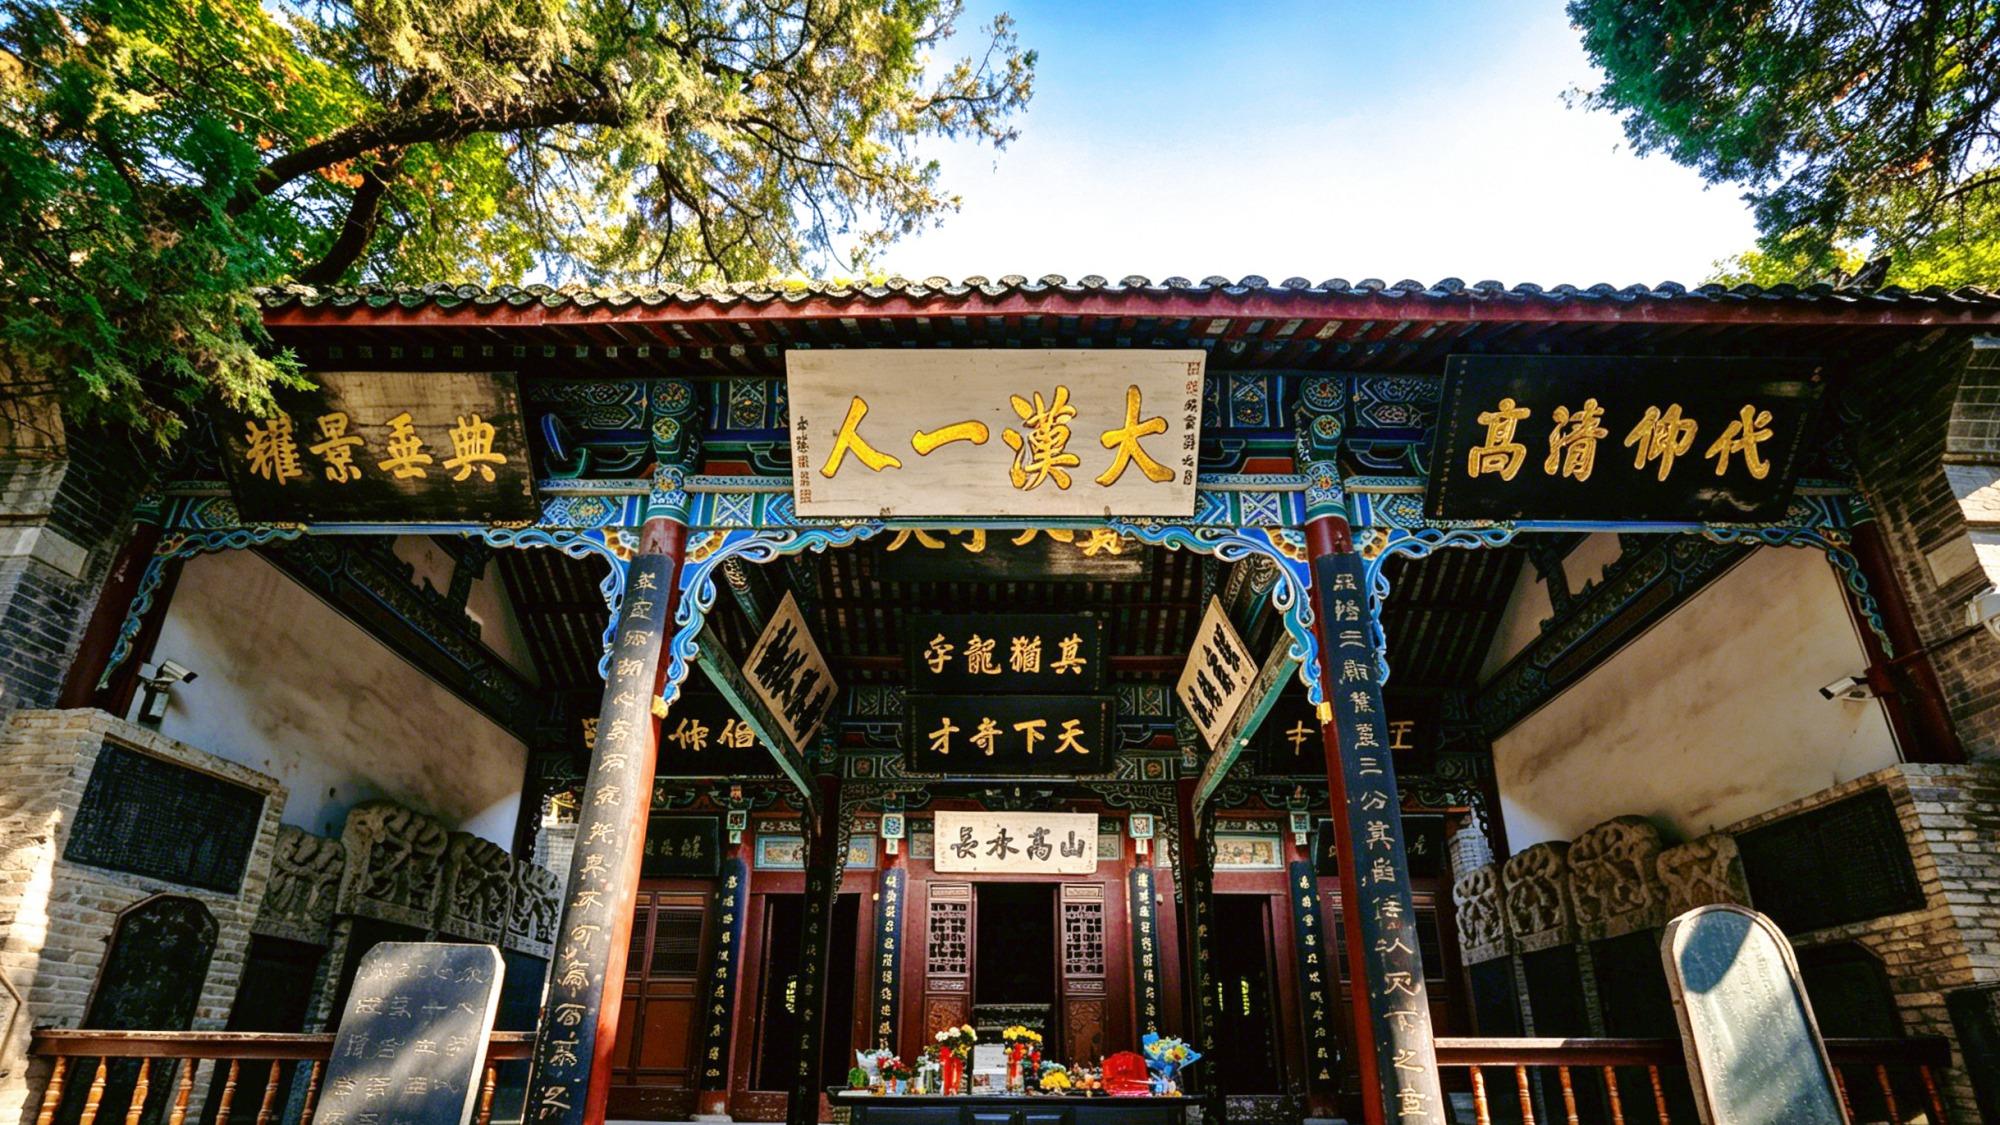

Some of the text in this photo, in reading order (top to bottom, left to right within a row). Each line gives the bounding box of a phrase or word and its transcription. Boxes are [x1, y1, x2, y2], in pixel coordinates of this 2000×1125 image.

[928, 716, 1090, 756] 天下奇才
[950, 826, 1086, 862] 山高水長
